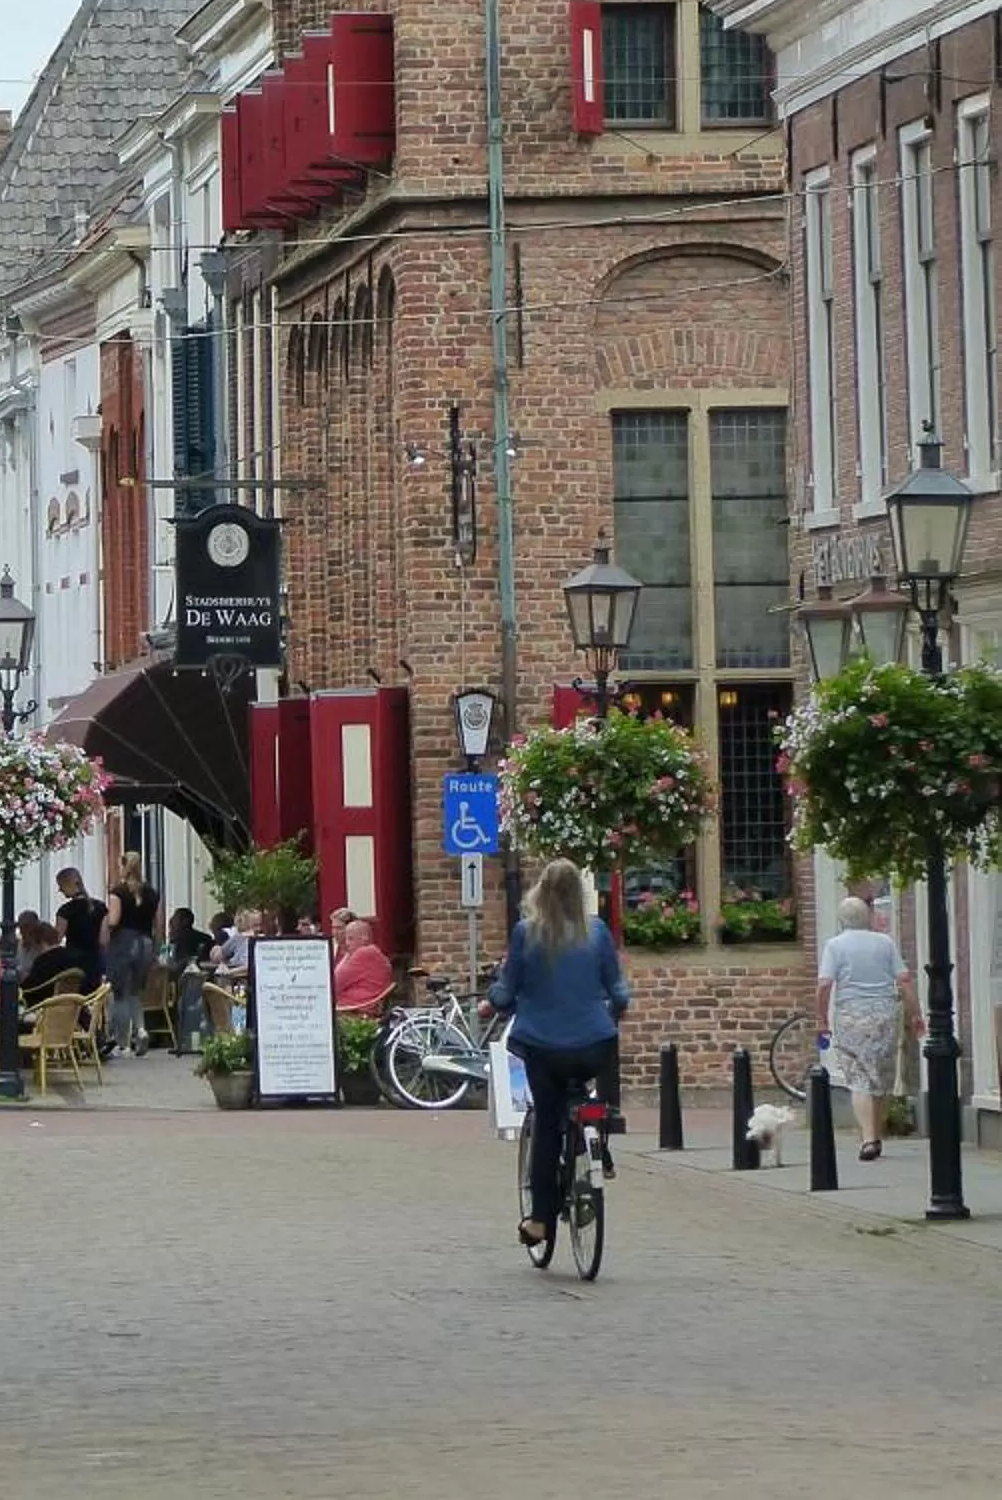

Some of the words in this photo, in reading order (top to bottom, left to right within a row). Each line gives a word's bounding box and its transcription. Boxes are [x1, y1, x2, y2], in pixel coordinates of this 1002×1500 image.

[186, 609, 211, 626] DE
[215, 609, 271, 626] WAAG
[449, 779, 493, 793] Route
